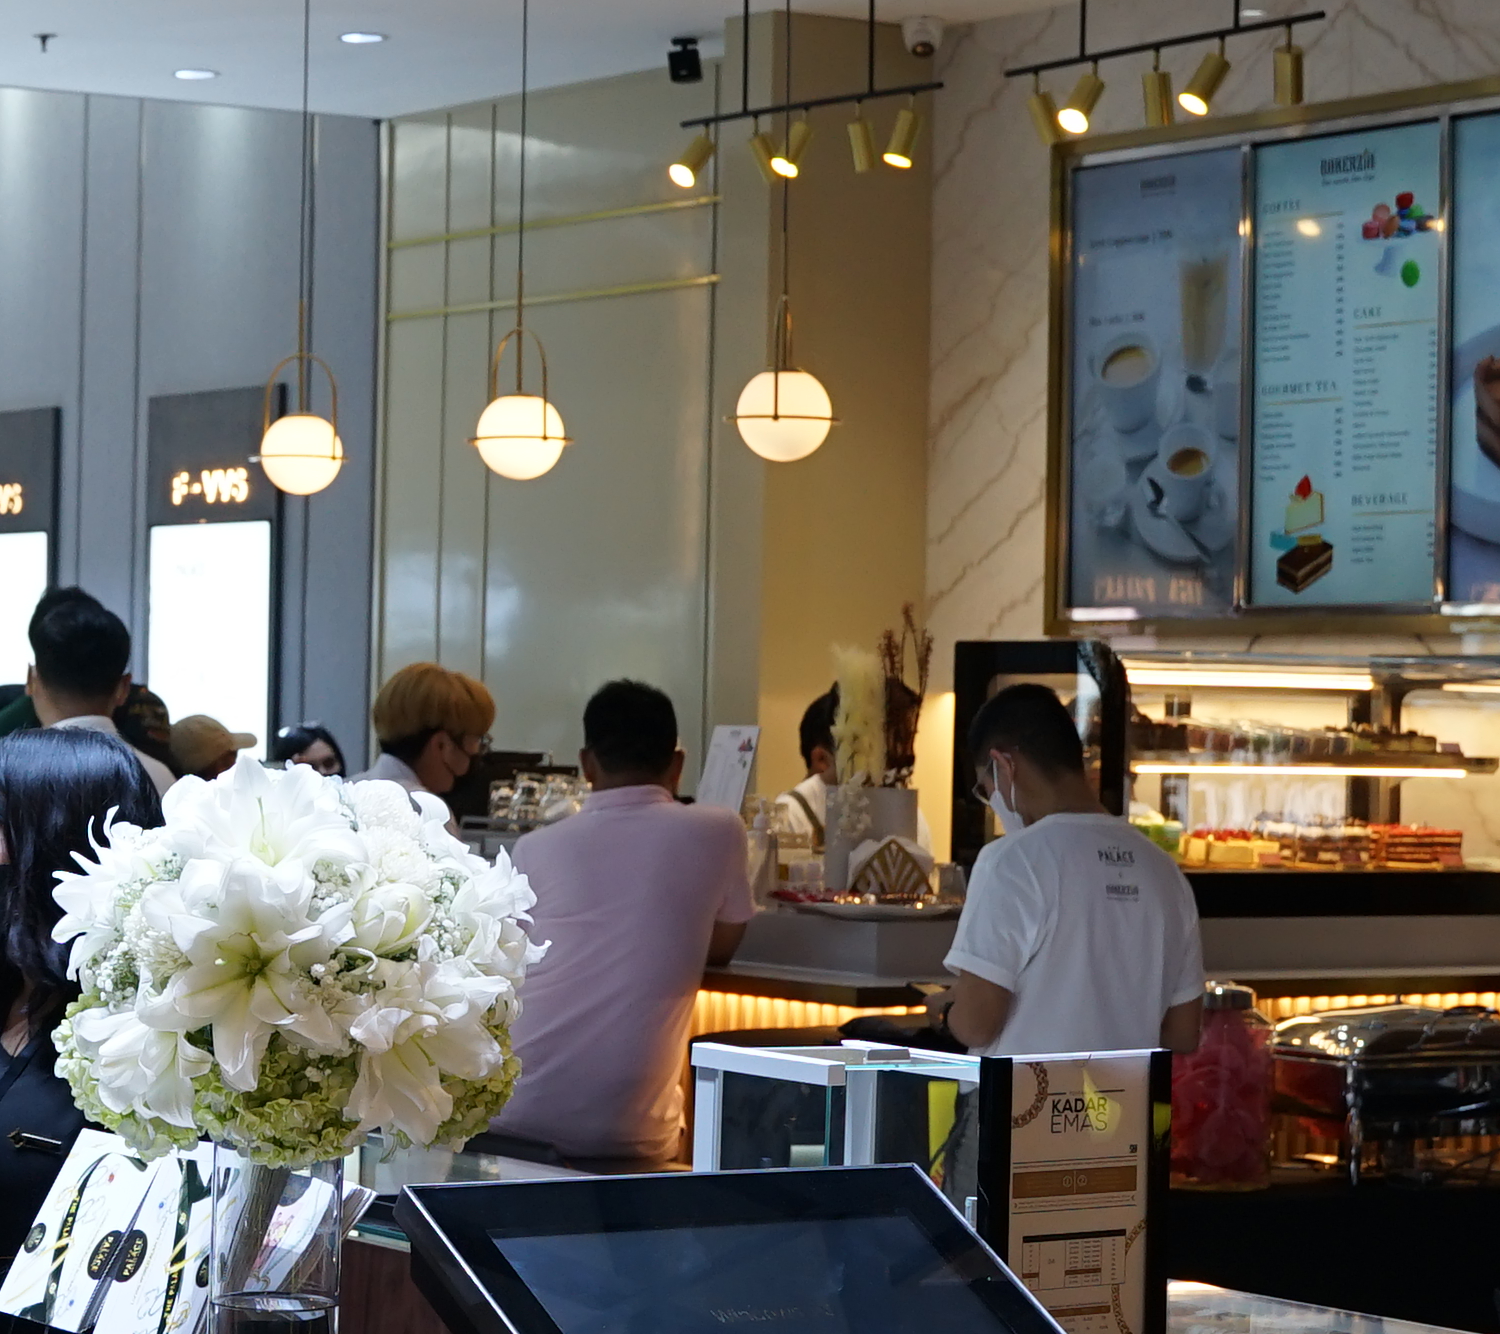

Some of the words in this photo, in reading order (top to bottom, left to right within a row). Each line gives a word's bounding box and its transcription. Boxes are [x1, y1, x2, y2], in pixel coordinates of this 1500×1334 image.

[1051, 1096, 1108, 1115] KADAR
[1050, 1112, 1108, 1134] EMAS
[122, 1237, 144, 1276] PALACE
